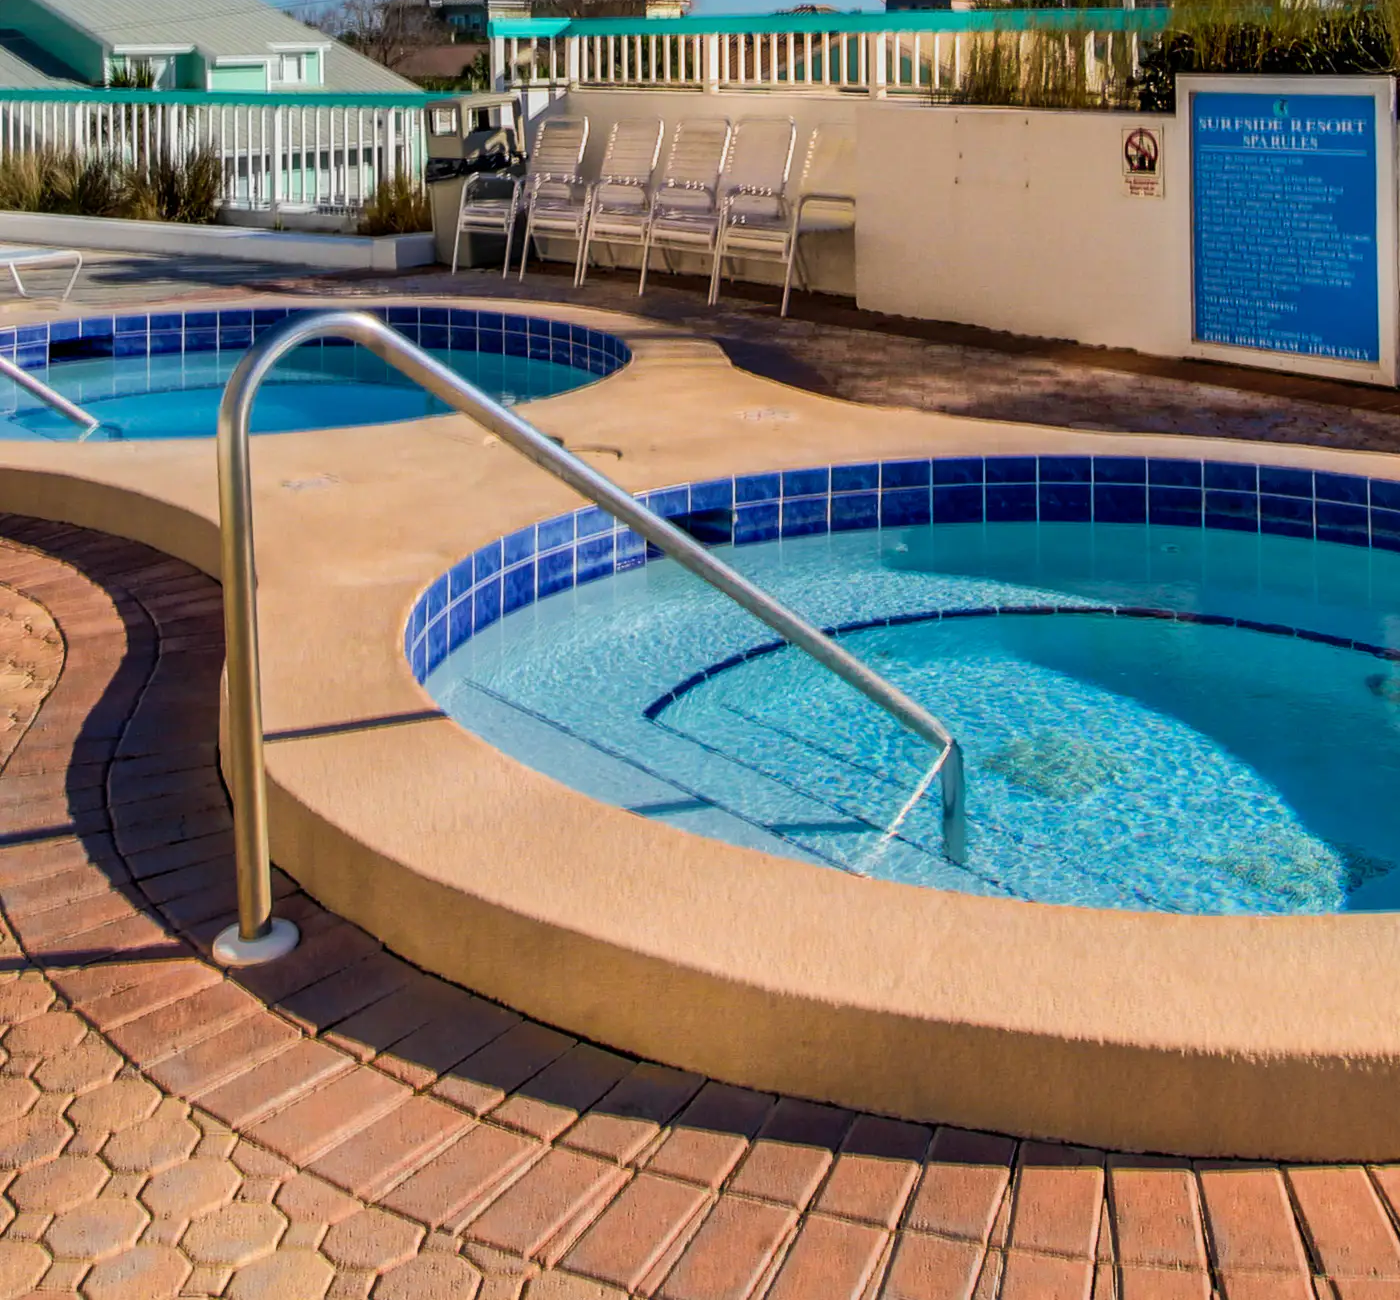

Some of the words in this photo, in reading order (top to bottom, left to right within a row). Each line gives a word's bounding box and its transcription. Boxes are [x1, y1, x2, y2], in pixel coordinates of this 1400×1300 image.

[1199, 116, 1284, 133] SURFSIDE
[1291, 118, 1367, 136] RESORT
[1243, 134, 1268, 149] SPA
[1271, 135, 1318, 150] RULES
